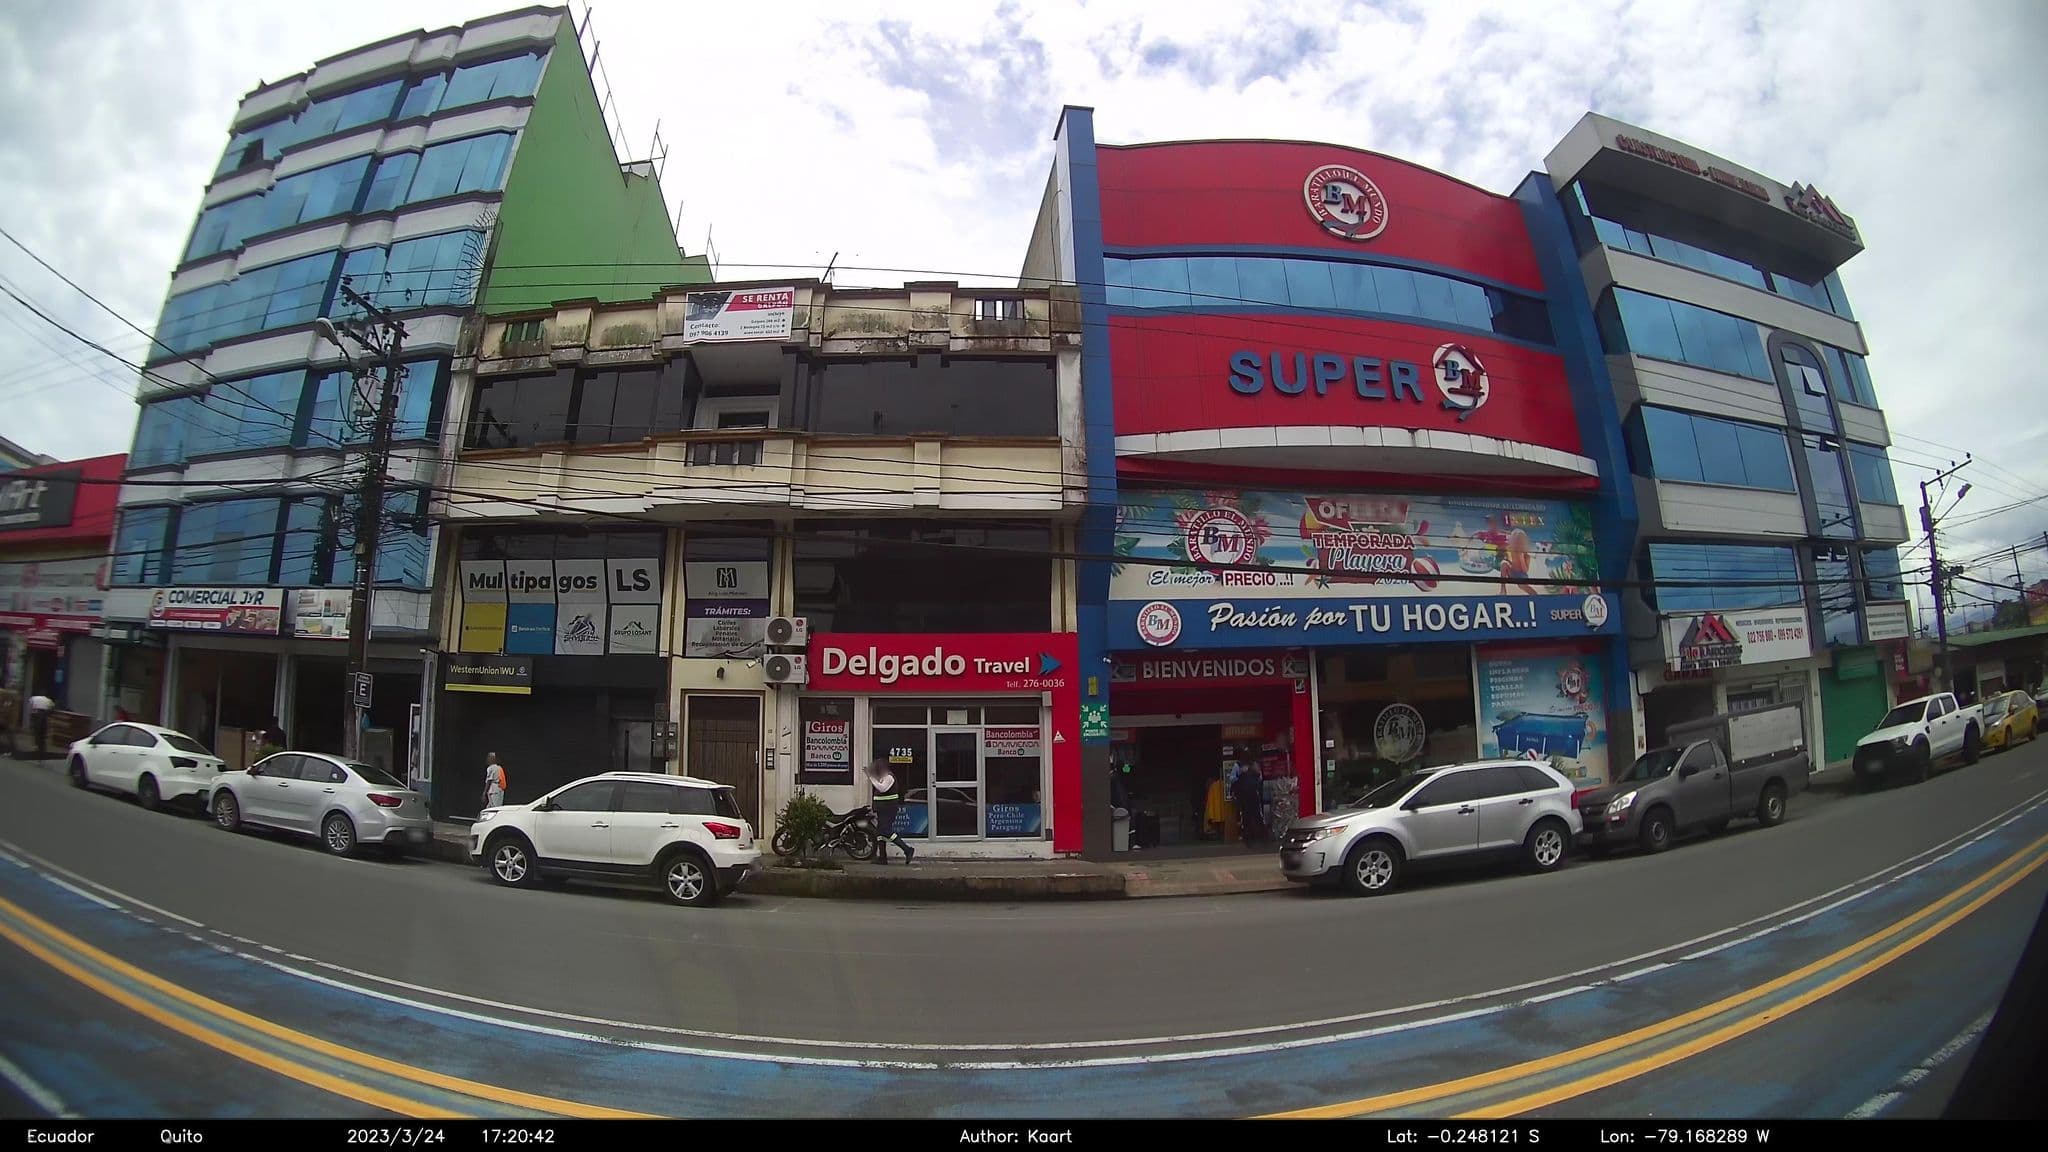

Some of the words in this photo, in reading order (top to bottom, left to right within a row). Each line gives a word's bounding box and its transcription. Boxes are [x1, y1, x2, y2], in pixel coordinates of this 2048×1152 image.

[757, 293, 788, 302] RENTA
[1228, 350, 1424, 402] SUPER
[1312, 532, 1415, 550] TEMPORADA
[1329, 546, 1407, 573] Playera
[469, 570, 599, 594] Multipagos
[615, 568, 651, 592] LS
[1150, 571, 1169, 586] El
[1173, 573, 1212, 589] mejor
[1225, 572, 1276, 586] PRECIO
[168, 590, 238, 605] COMERCIAL
[704, 606, 752, 615] TRÁMITES:
[1207, 601, 1298, 631] Pasión
[1303, 606, 1348, 630] por
[1349, 605, 1391, 633] TU
[1550, 609, 1583, 620] SUPER
[822, 646, 966, 683] Delgado
[973, 657, 1030, 674] Travel
[1142, 659, 1275, 679] BIENVENIDOS
[359, 682, 367, 696] E
[1023, 678, 1065, 688] 276-0036
[811, 721, 844, 733] Giros
[985, 730, 1033, 739] Bancolombia
[889, 747, 912, 756] 4735
[992, 804, 1020, 813] Giros
